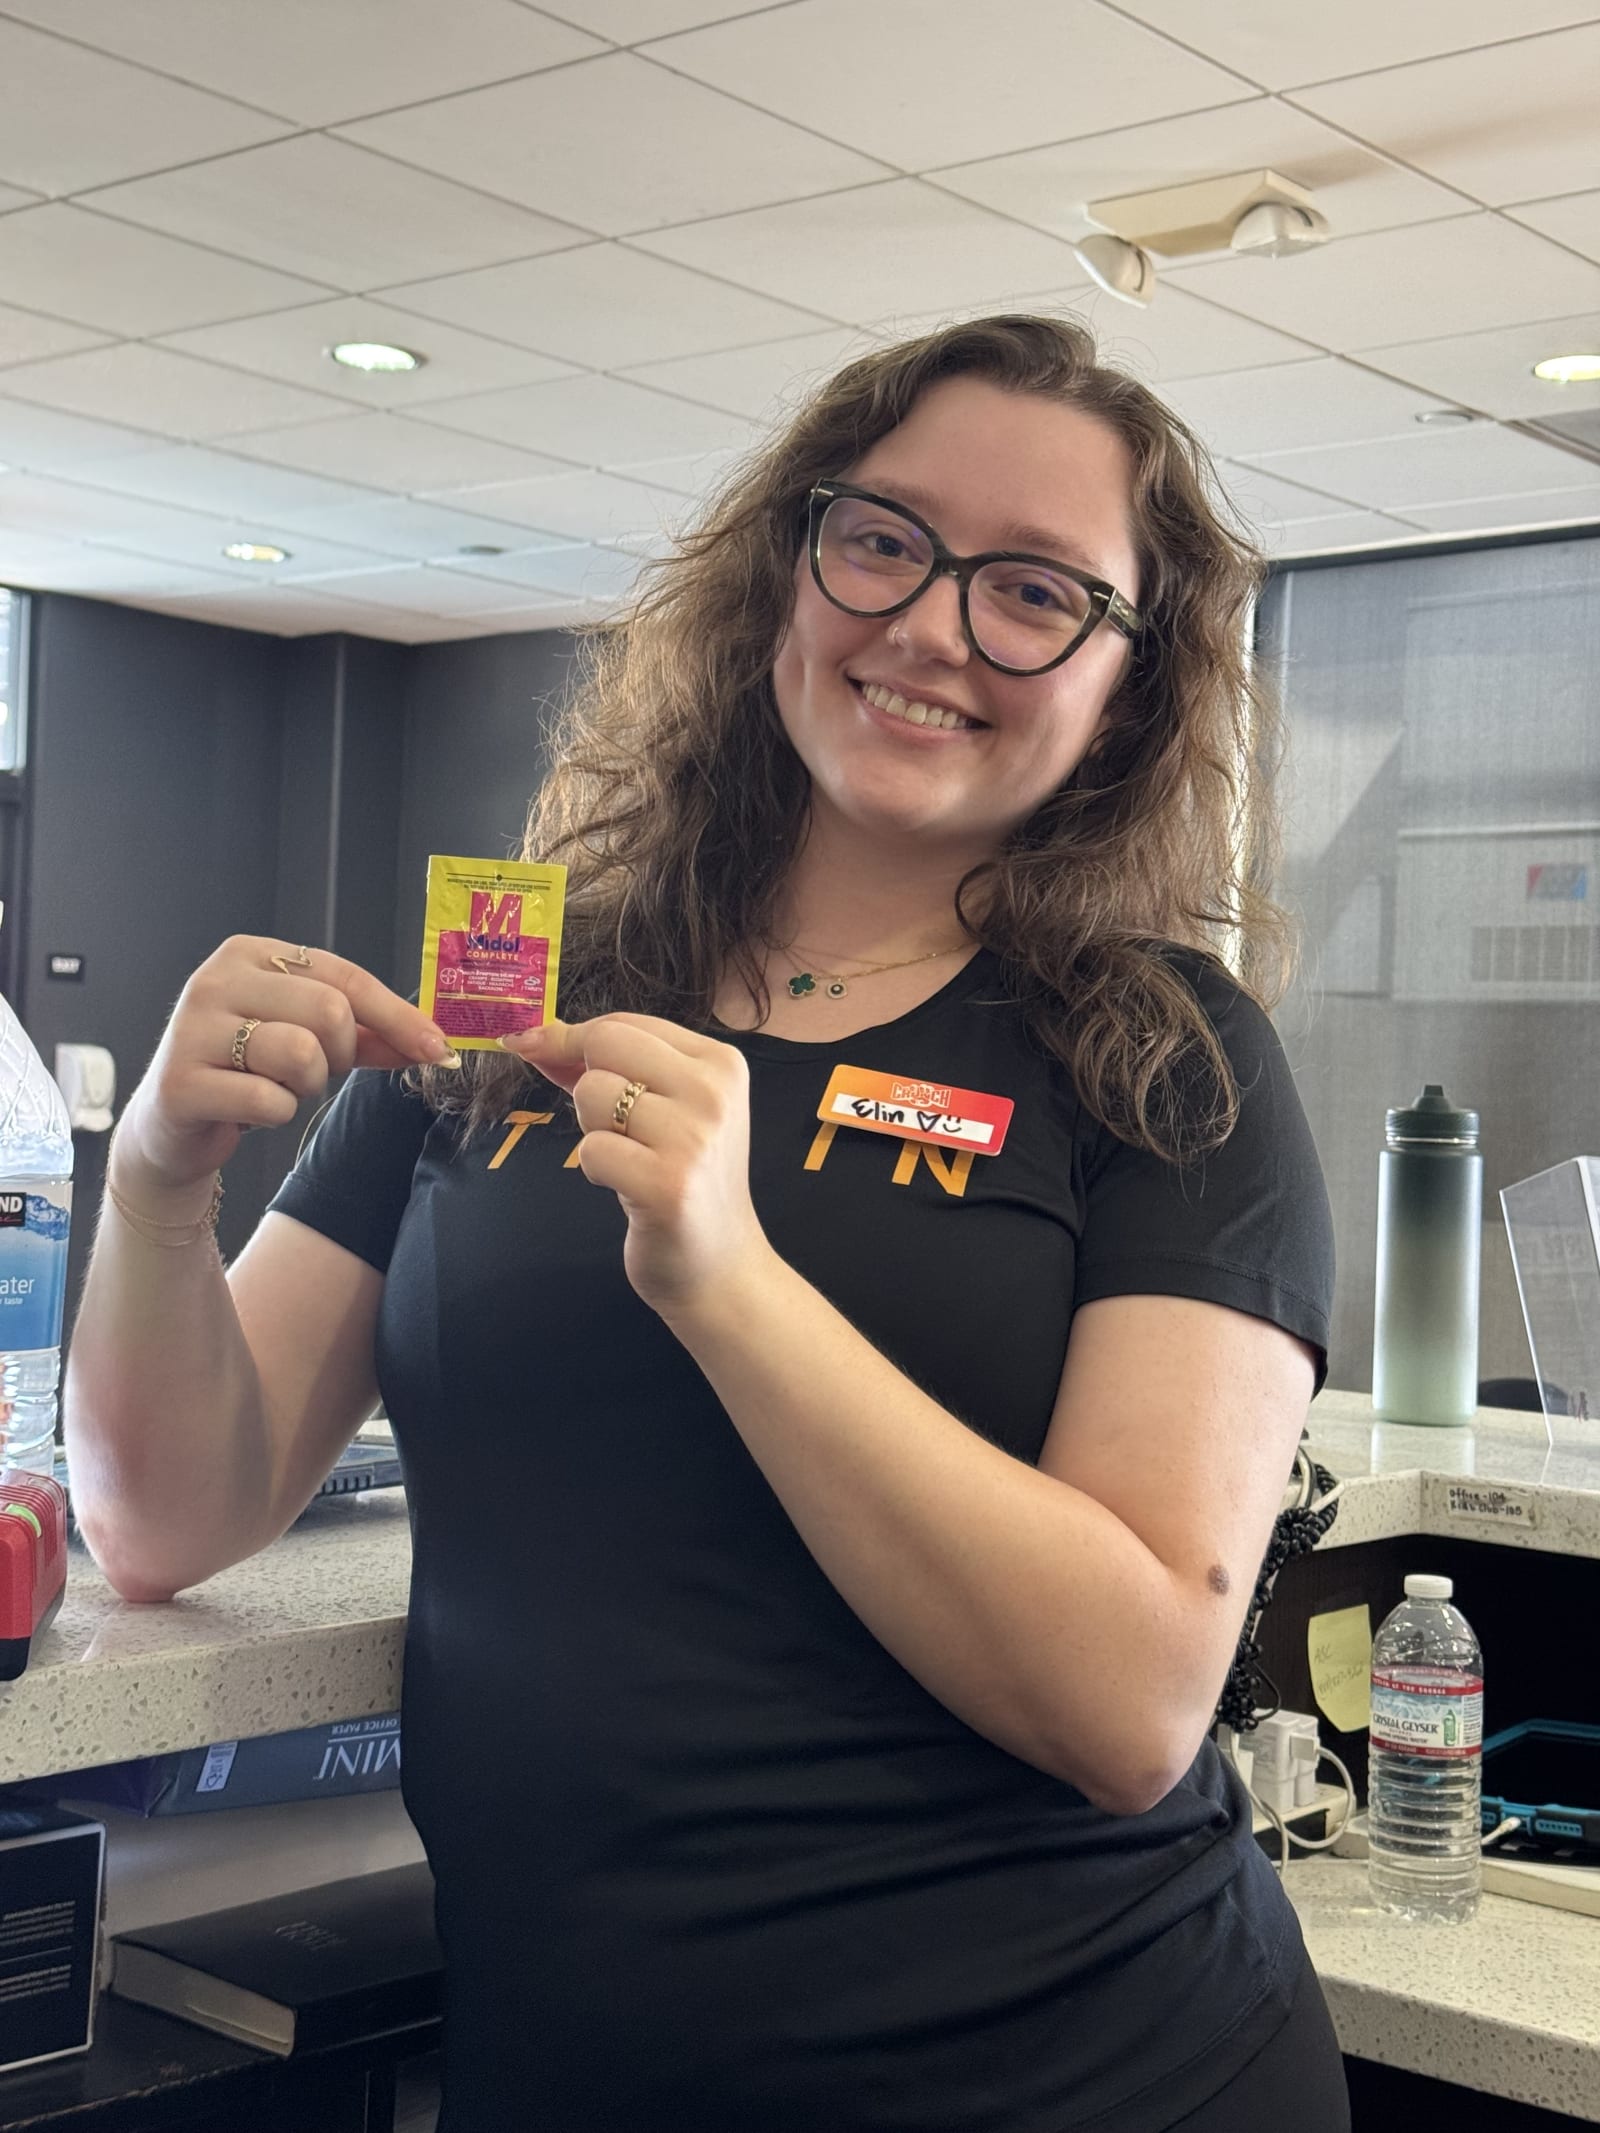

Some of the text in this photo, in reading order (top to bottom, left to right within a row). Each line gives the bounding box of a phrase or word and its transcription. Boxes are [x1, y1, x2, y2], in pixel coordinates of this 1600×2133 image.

[466, 934, 521, 953] Midol
[466, 950, 519, 962] COMPLETE
[891, 1082, 951, 1108] CRUNCH
[851, 1099, 905, 1123] Elin
[0, 1276, 35, 1295] ater
[332, 1718, 398, 1736] OFFICE PAPER
[1373, 1713, 1399, 1730] CRYSTAL
[1401, 1720, 1438, 1735] GEYSER
